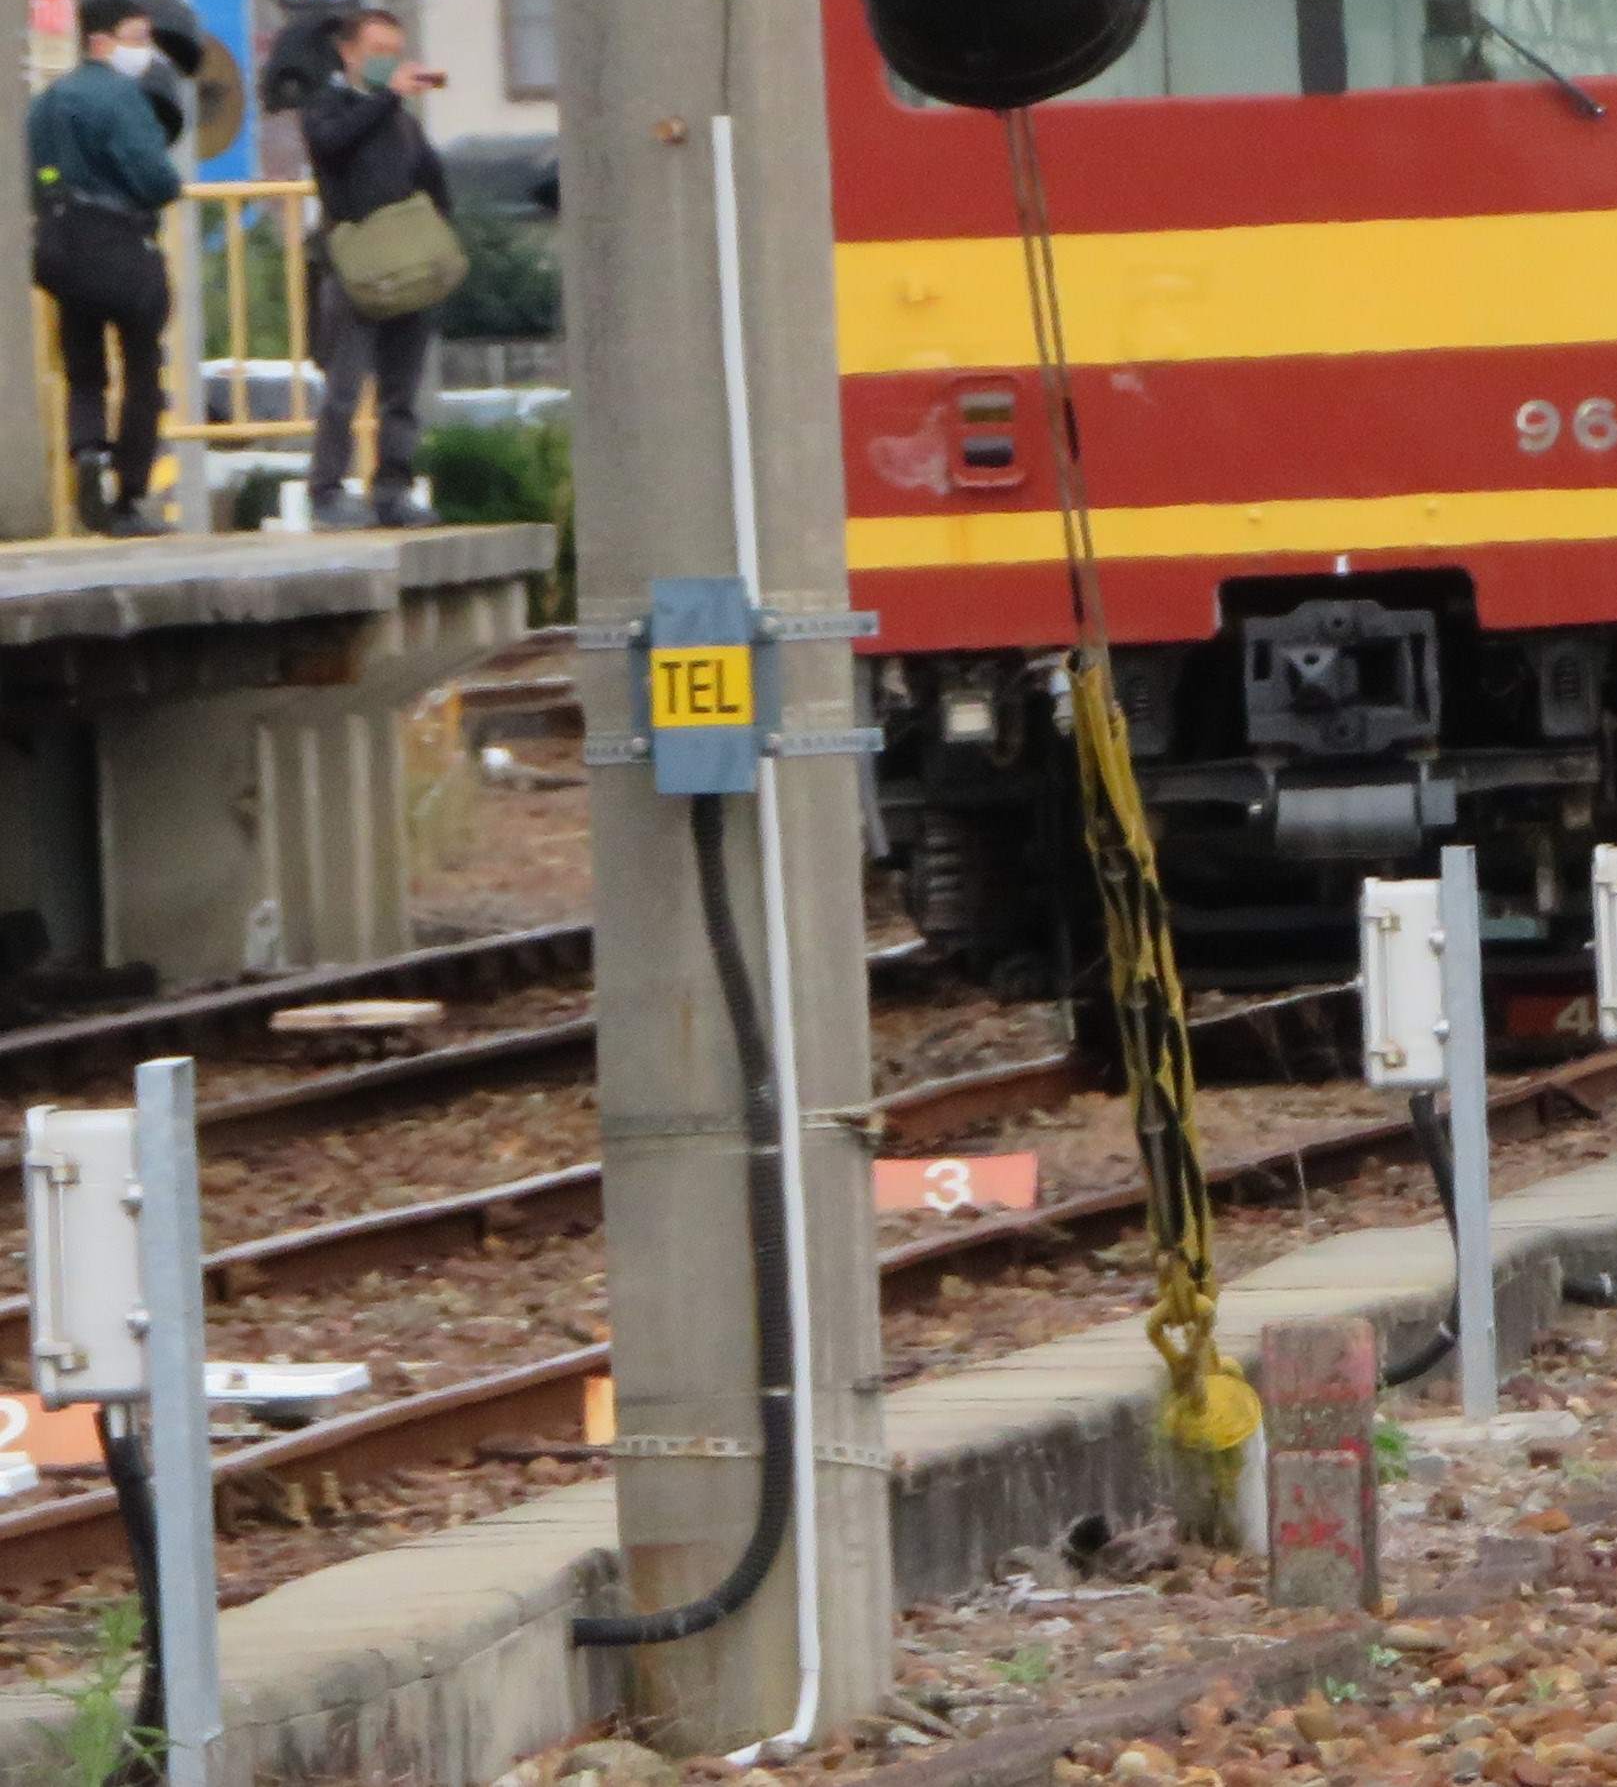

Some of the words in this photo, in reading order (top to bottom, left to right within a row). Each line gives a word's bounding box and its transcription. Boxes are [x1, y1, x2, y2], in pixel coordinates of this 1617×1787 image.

[659, 659, 740, 714] TEL
[1556, 996, 1595, 1036] 4
[924, 1159, 972, 1215] 3
